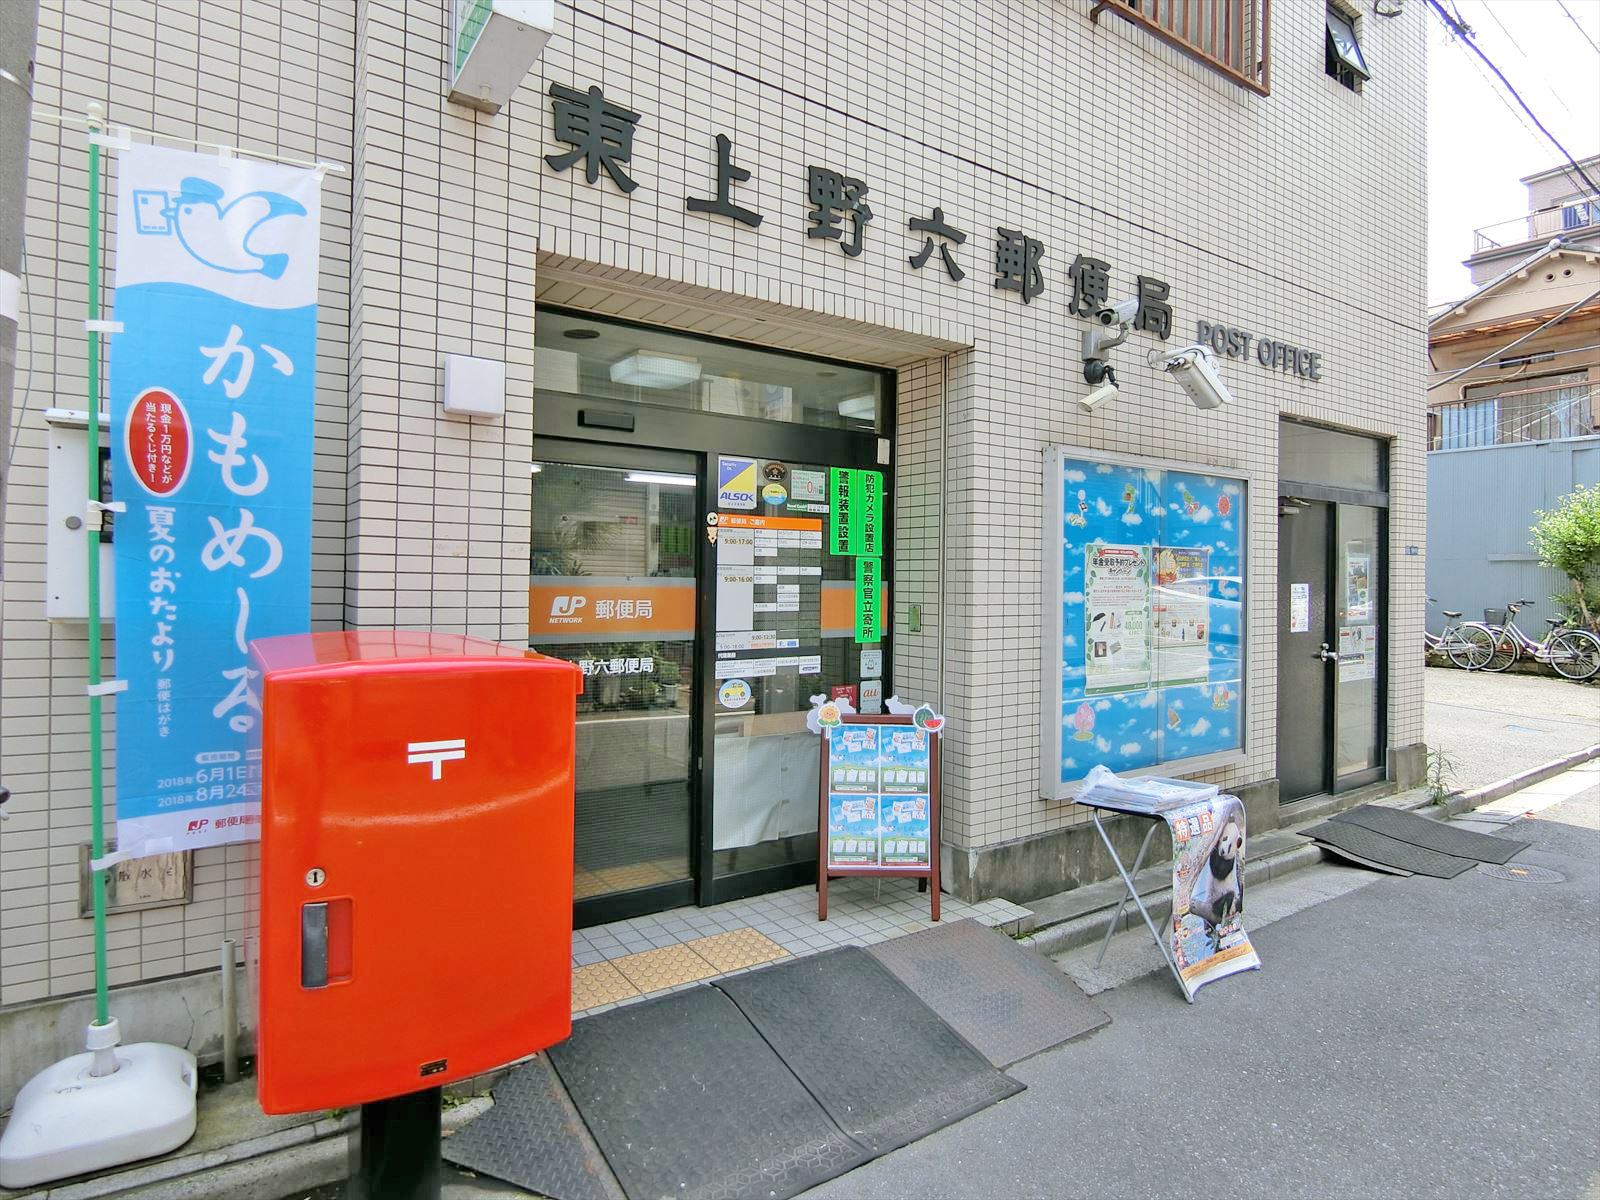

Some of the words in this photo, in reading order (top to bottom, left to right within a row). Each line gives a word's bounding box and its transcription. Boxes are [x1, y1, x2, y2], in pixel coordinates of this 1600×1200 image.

[544, 82, 1173, 340] 東上野六郵便局
[1198, 320, 1252, 360] POST
[1257, 338, 1321, 380] OFFICE
[161, 403, 173, 484] 現金1万円などが
[720, 491, 754, 502] ALSOK
[838, 470, 849, 553] 警報装置設置
[864, 473, 876, 553] 防犯カメラ設置店
[145, 505, 181, 672] 夏のおたより
[595, 599, 653, 619] 郵便局
[862, 561, 873, 639] 警察官立寄所
[157, 678, 172, 738] 郵便はがき
[1174, 812, 1213, 840] 特選品
